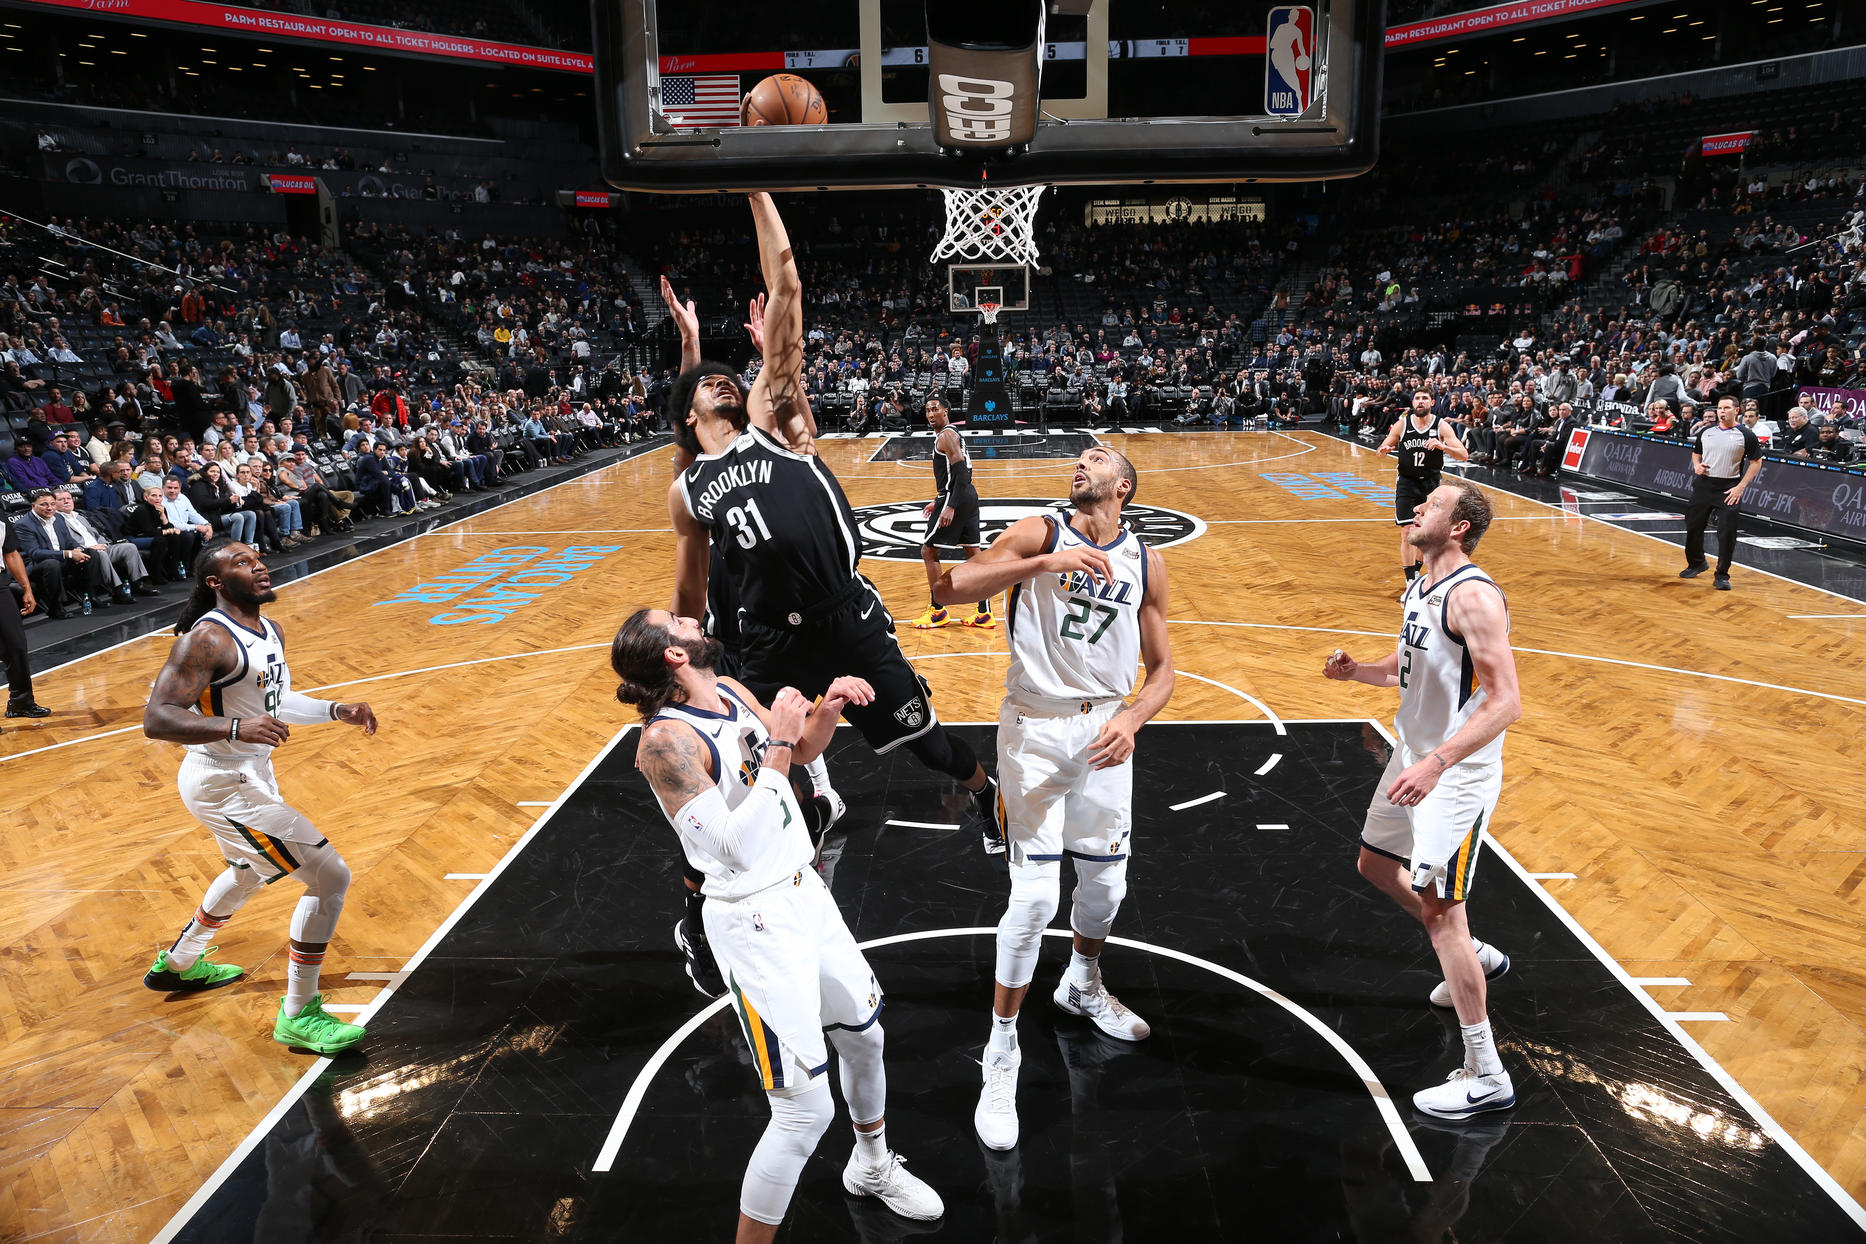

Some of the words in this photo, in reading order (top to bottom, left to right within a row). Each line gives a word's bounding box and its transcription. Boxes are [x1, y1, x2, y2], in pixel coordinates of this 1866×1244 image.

[1385, 32, 1408, 43] PARM
[1409, 20, 1466, 38] RESTAURANT
[1467, 15, 1494, 29] OPEN
[1495, 11, 1509, 22] TO
[1510, 7, 1529, 19] ALL
[1530, 1, 1566, 15] TICKET
[225, 13, 256, 26] PARM
[258, 17, 326, 35] RESTAURANT
[328, 27, 358, 39] OPEN
[360, 31, 374, 41] TO
[376, 34, 394, 44] ALL
[396, 35, 430, 48] TICKET
[431, 41, 474, 54] HOLDERS
[480, 47, 521, 60] LOCATED
[522, 52, 535, 61] ON
[537, 54, 561, 65] SUITE
[562, 58, 586, 68] LEVEL
[1047, 44, 1056, 59] 5
[914, 48, 924, 63] 6
[1271, 92, 1294, 110] NBA
[1713, 140, 1738, 150] LUCAS
[1738, 138, 1751, 147] OIL
[282, 180, 303, 189] LUCAS
[304, 181, 314, 189] OIL
[1105, 208, 1120, 217] WE
[1123, 208, 1136, 217] GO
[972, 413, 1009, 422] BARCLAYS
[1604, 401, 1640, 415] HONDA
[1412, 451, 1426, 467] 12
[1603, 441, 1642, 464] QATAR
[1653, 467, 1684, 489] AIRBUS
[697, 459, 773, 520] BROOKLYN
[1772, 493, 1796, 514] JFK
[725, 497, 773, 550] 31
[372, 546, 550, 607] CENTER
[429, 545, 624, 625] BARCLAYS
[1060, 597, 1119, 645] 27
[1400, 650, 1412, 689] 2
[896, 698, 921, 721] NETS
